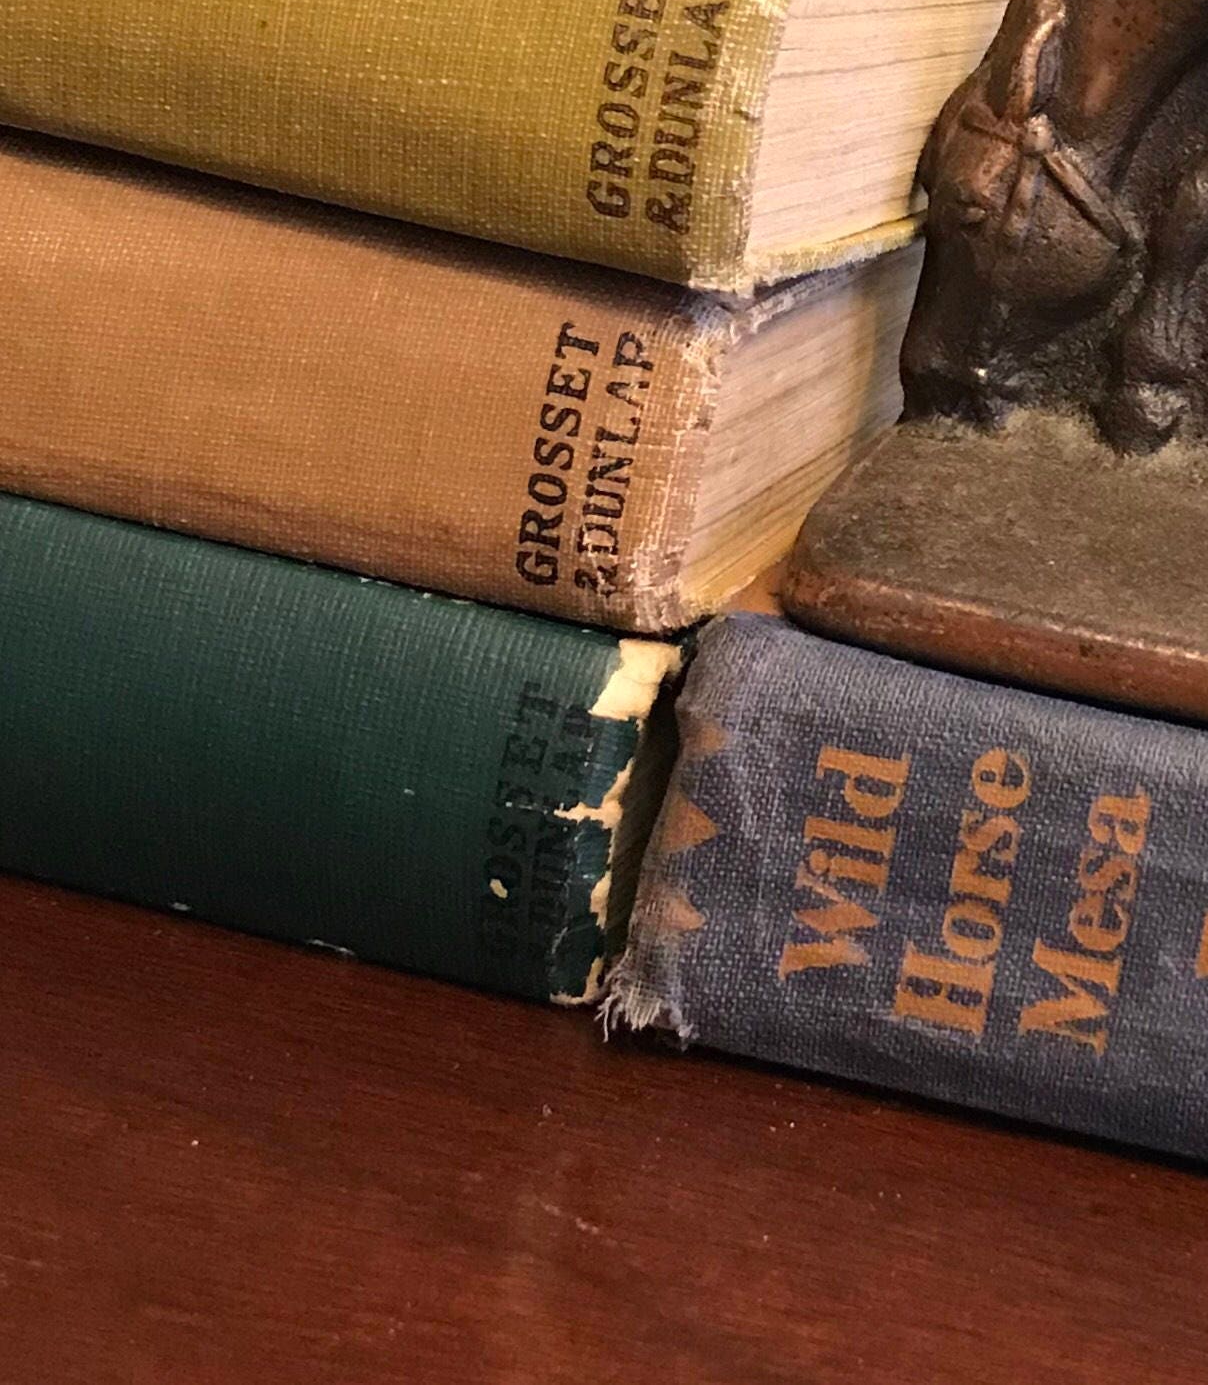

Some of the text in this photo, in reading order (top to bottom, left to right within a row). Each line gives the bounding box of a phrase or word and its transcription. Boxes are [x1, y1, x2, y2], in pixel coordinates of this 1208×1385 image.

[514, 321, 600, 588] GROSSET
[777, 746, 910, 981] Wild
[893, 748, 1031, 1040] Horse
[1020, 786, 1152, 1056] Mesa
